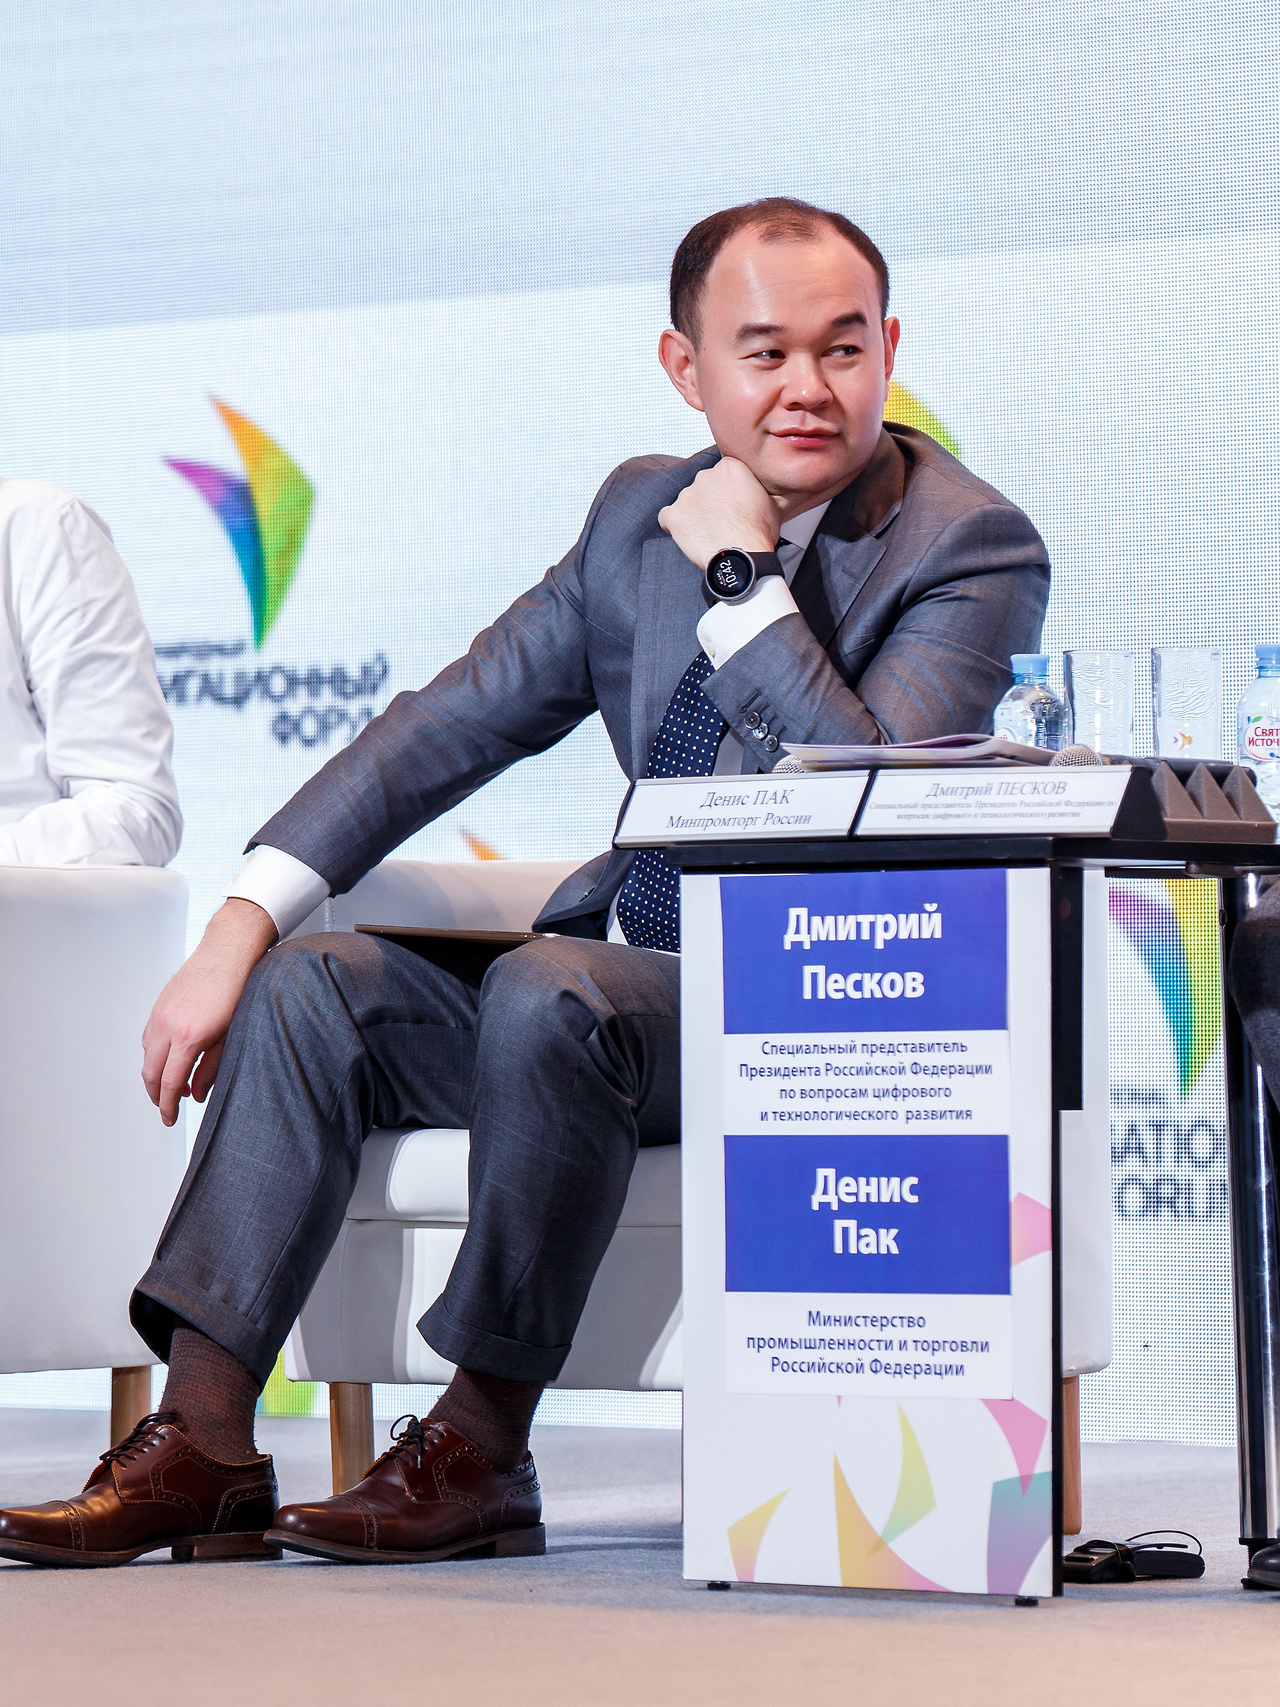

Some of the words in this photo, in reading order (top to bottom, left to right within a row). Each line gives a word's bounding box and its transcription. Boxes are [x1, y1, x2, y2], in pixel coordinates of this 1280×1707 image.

[720, 559, 738, 588] 10:42
[700, 791, 750, 810] Денис
[753, 789, 795, 806] ПАК
[927, 781, 994, 799] Дмитрий
[997, 781, 1068, 796] ПЕСКОВ
[666, 815, 761, 830] Минпромторг
[763, 813, 812, 826] России
[784, 903, 942, 950] Дмитрий
[803, 965, 925, 999] Песков
[762, 1040, 857, 1057] Специальный
[861, 1042, 968, 1057] представитель
[740, 1064, 821, 1081] Президента
[825, 1062, 906, 1076] Российской
[910, 1062, 992, 1079] Федерации
[780, 1089, 796, 1099] по
[800, 1088, 868, 1102] вопросам
[873, 1084, 952, 1101] цифрового
[761, 1112, 768, 1121] и
[772, 1110, 898, 1121] технологического
[906, 1110, 972, 1124] развития
[811, 1168, 919, 1210] Денис
[834, 1220, 899, 1254] Пак
[808, 1311, 926, 1332] Министерство
[747, 1337, 893, 1353] промышленности
[899, 1340, 908, 1351] и
[912, 1340, 989, 1356] торговли
[772, 1357, 864, 1374] Российской
[870, 1358, 964, 1379] Федерации
